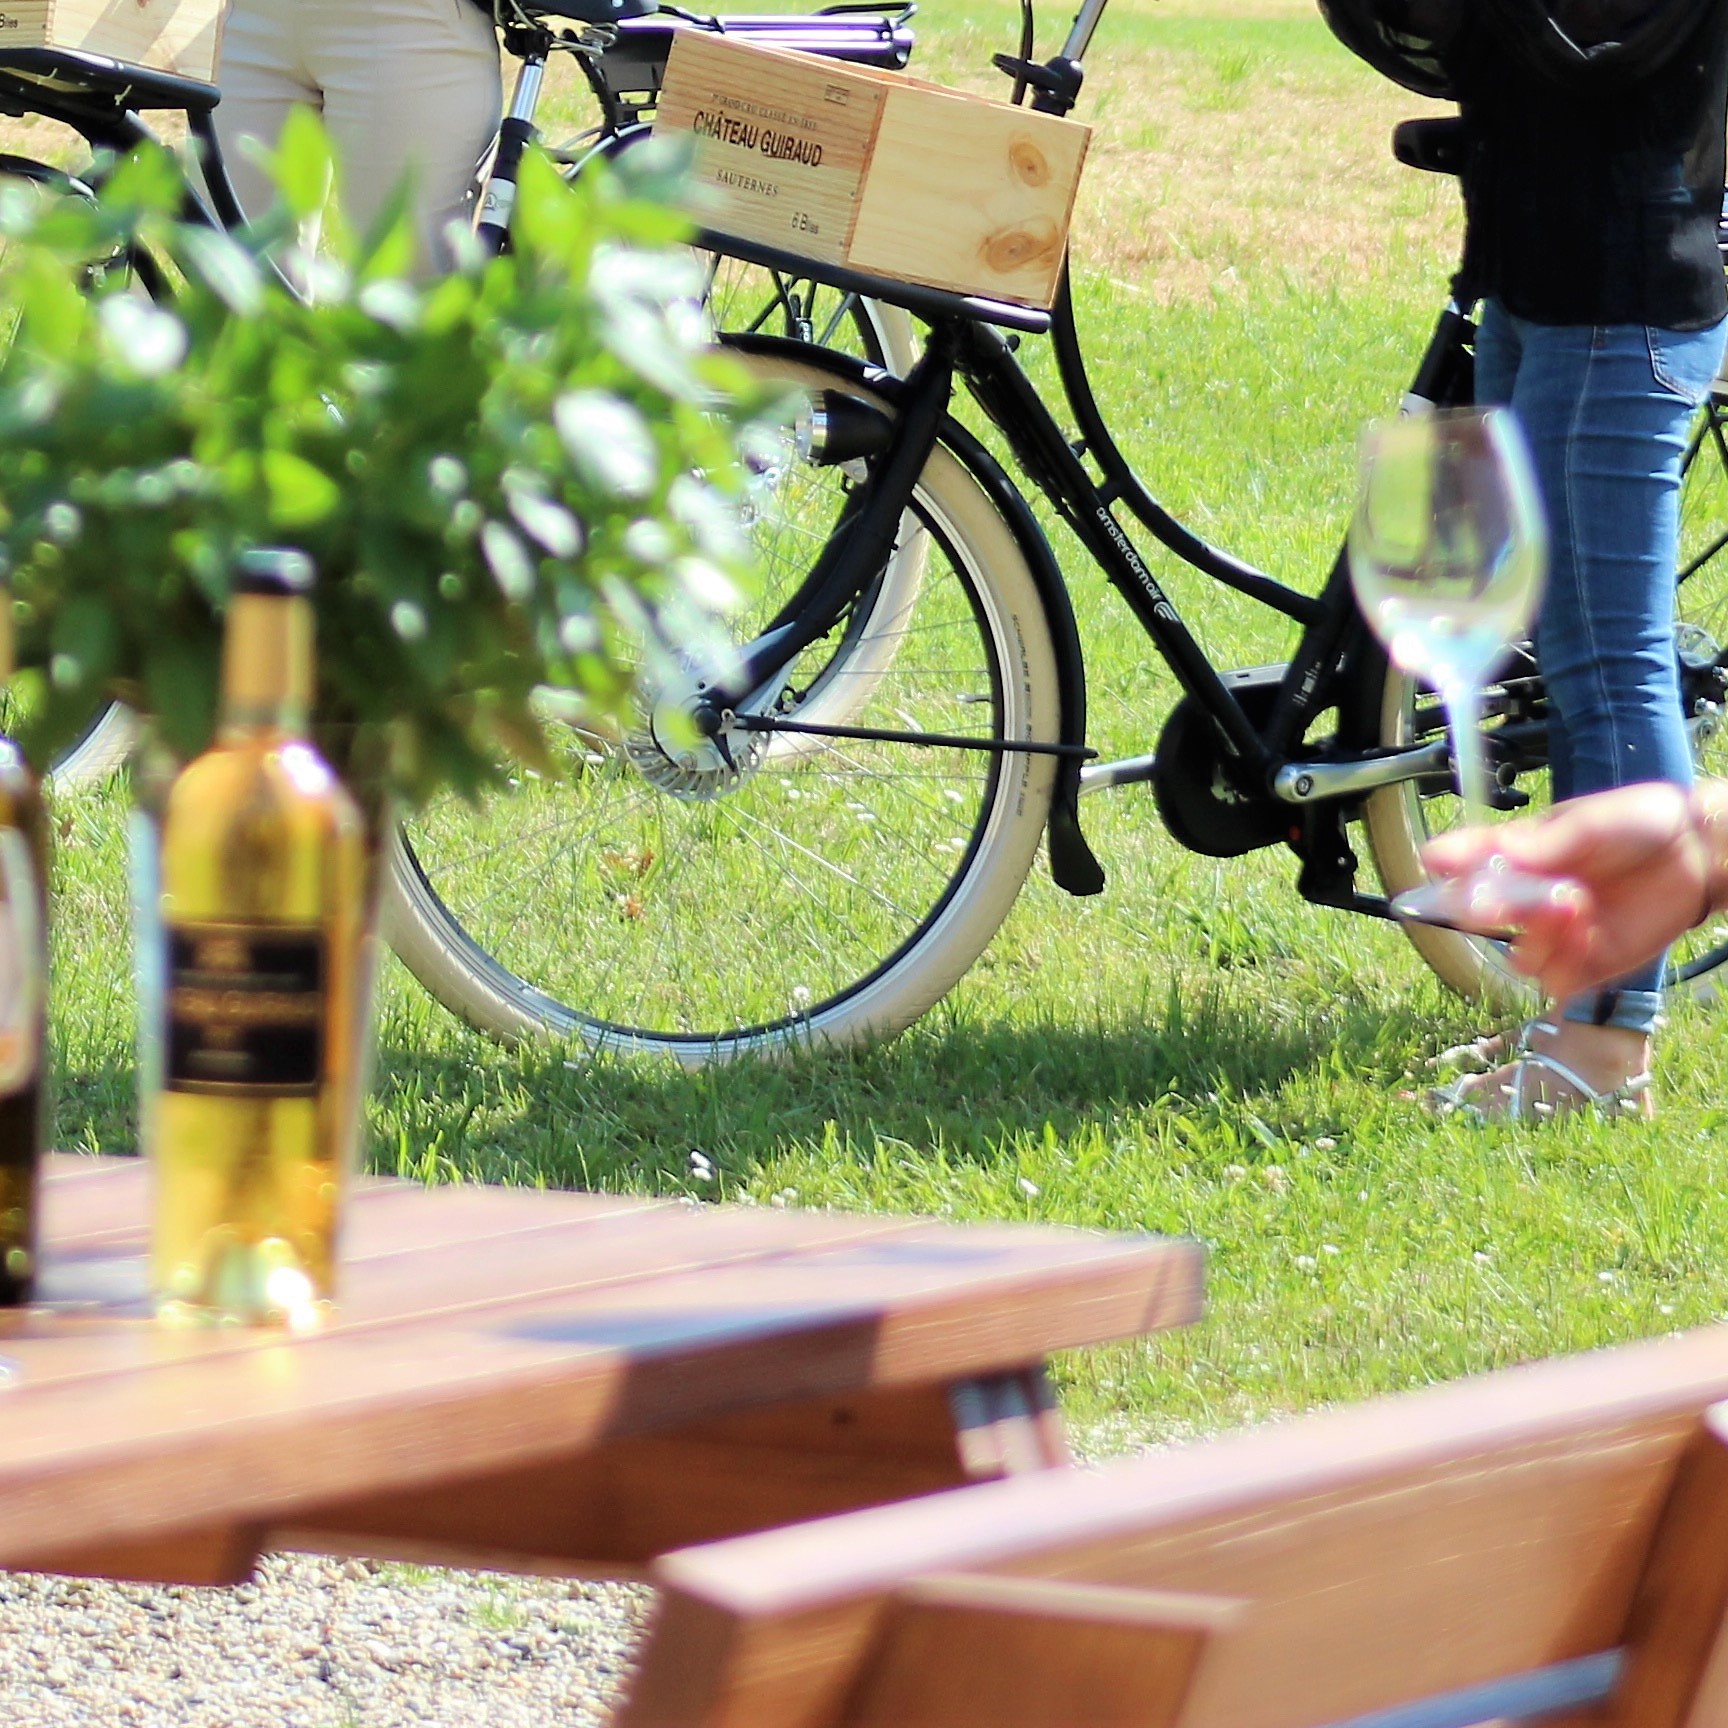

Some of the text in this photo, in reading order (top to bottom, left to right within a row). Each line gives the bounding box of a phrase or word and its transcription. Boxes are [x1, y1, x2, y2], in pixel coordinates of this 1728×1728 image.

[693, 110, 822, 167] CHÂTEAU GUIRAUD
[716, 169, 779, 197] SAUTERNES
